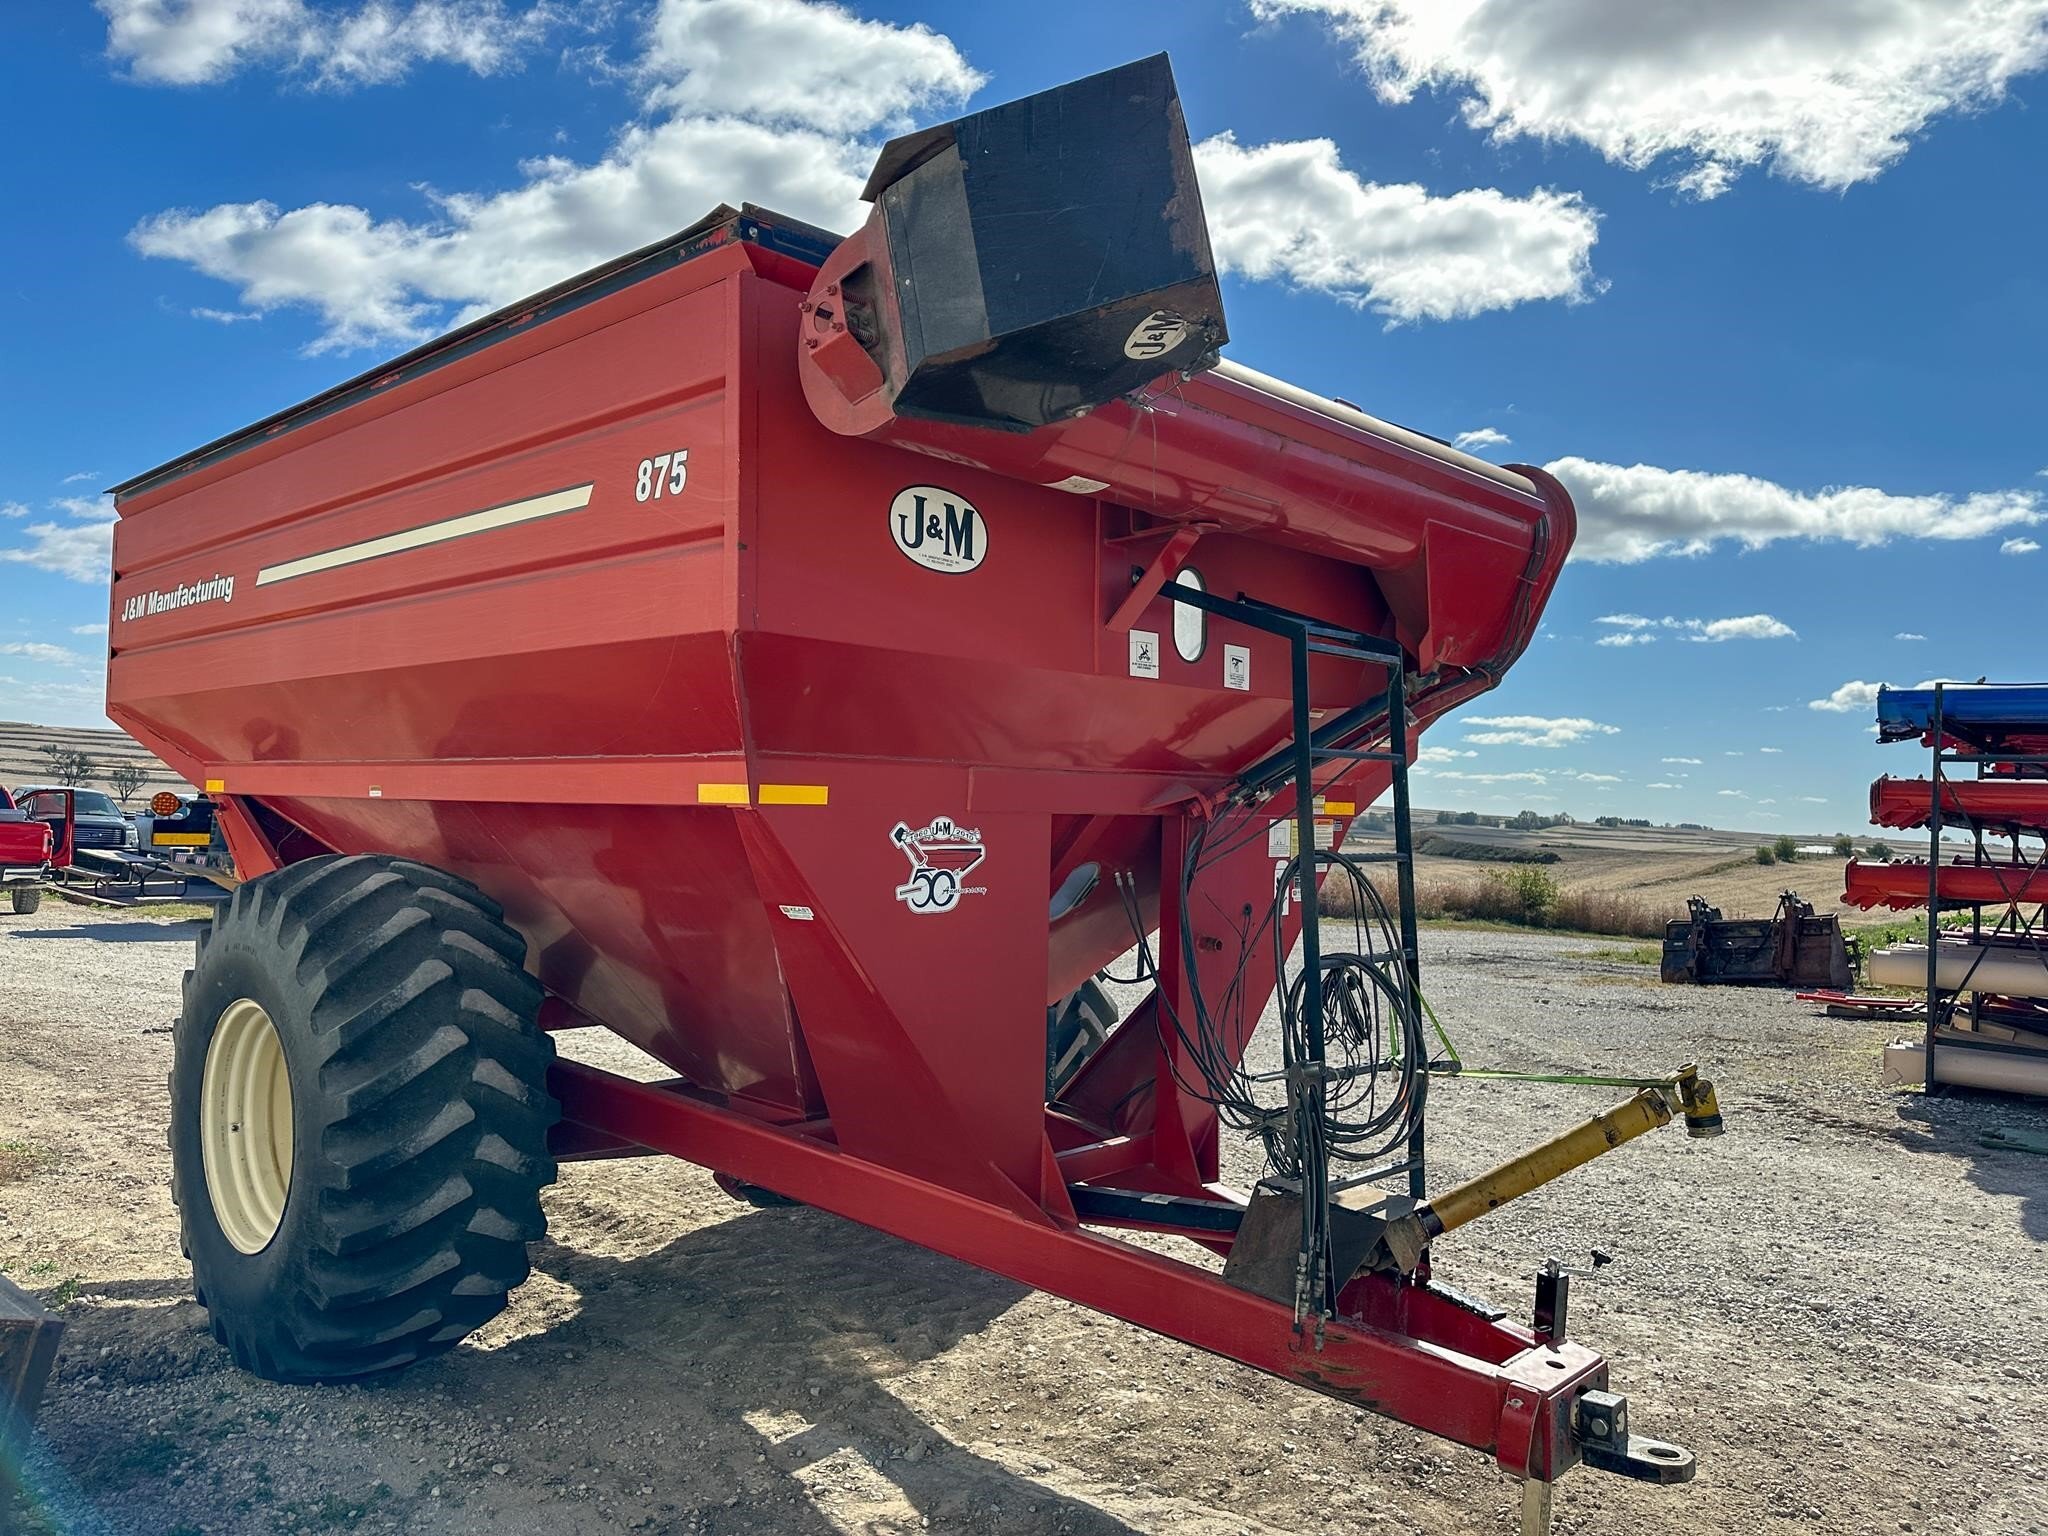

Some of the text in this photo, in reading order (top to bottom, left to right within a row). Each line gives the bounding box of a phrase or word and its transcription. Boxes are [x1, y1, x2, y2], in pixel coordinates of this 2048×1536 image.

[1131, 310, 1184, 356] J&M
[635, 449, 688, 503] 875
[898, 495, 975, 562] J&M
[121, 573, 235, 623] J&M Manufacturing
[932, 822, 951, 836] J&M
[957, 829, 974, 841] 2010
[912, 868, 956, 908] 50
